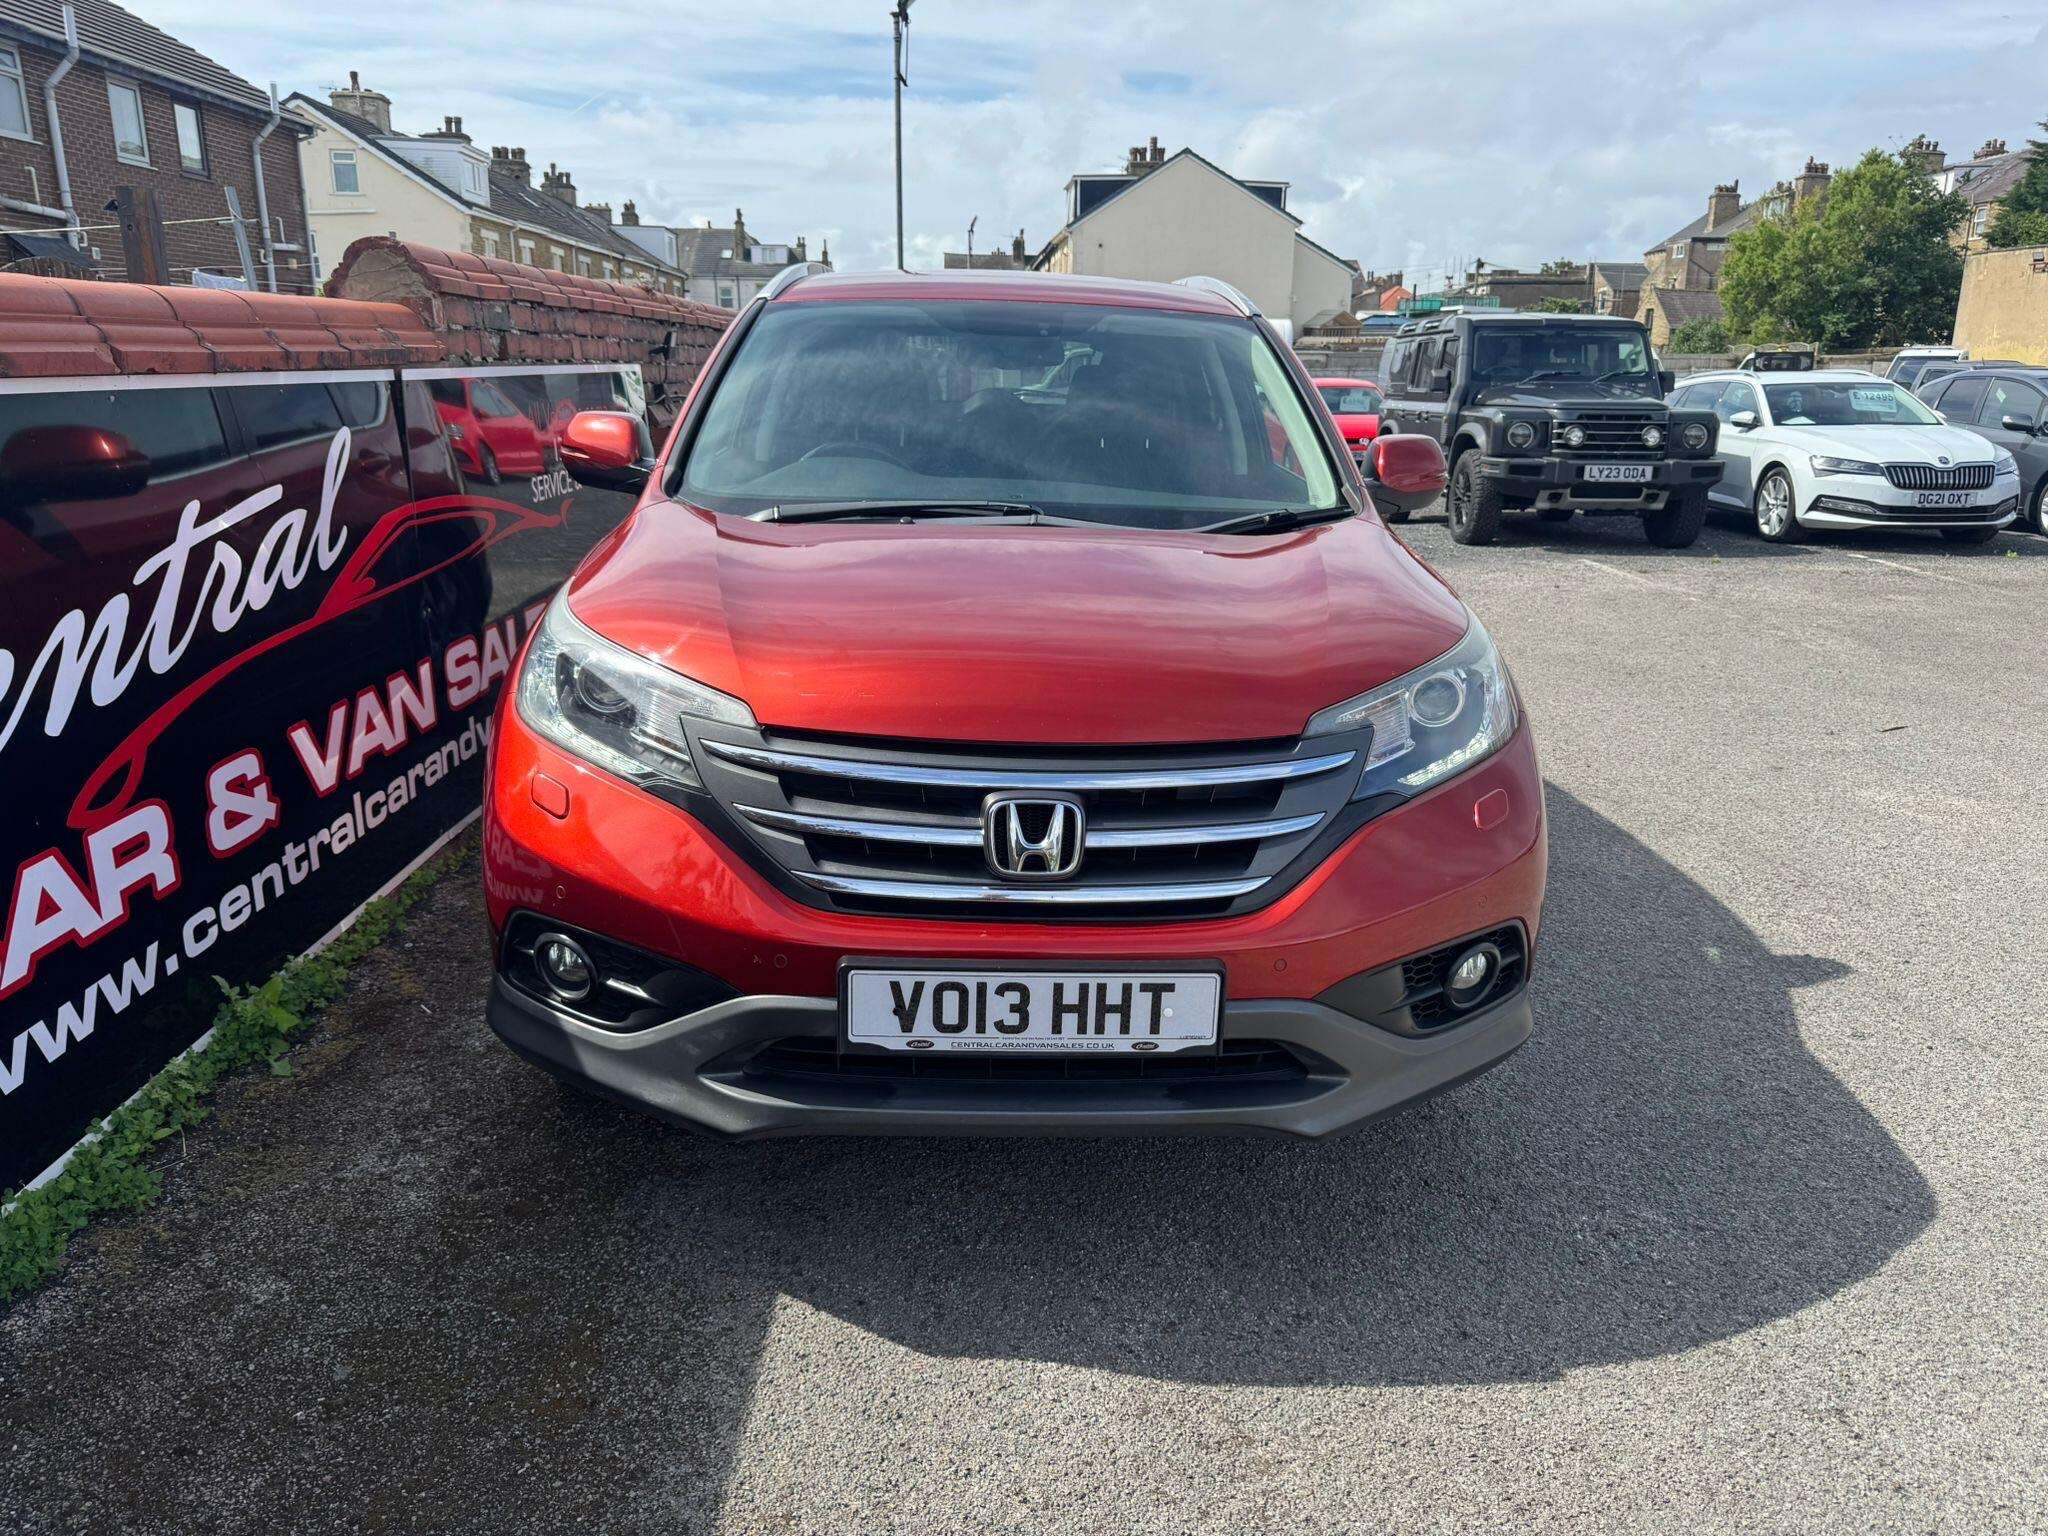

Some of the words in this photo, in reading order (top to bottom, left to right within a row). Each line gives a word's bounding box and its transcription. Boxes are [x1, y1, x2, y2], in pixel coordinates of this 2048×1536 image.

[1589, 467, 1620, 479] LY23
[209, 751, 276, 851] &
[293, 663, 436, 793] VAN
[1050, 982, 1176, 1036] HHT
